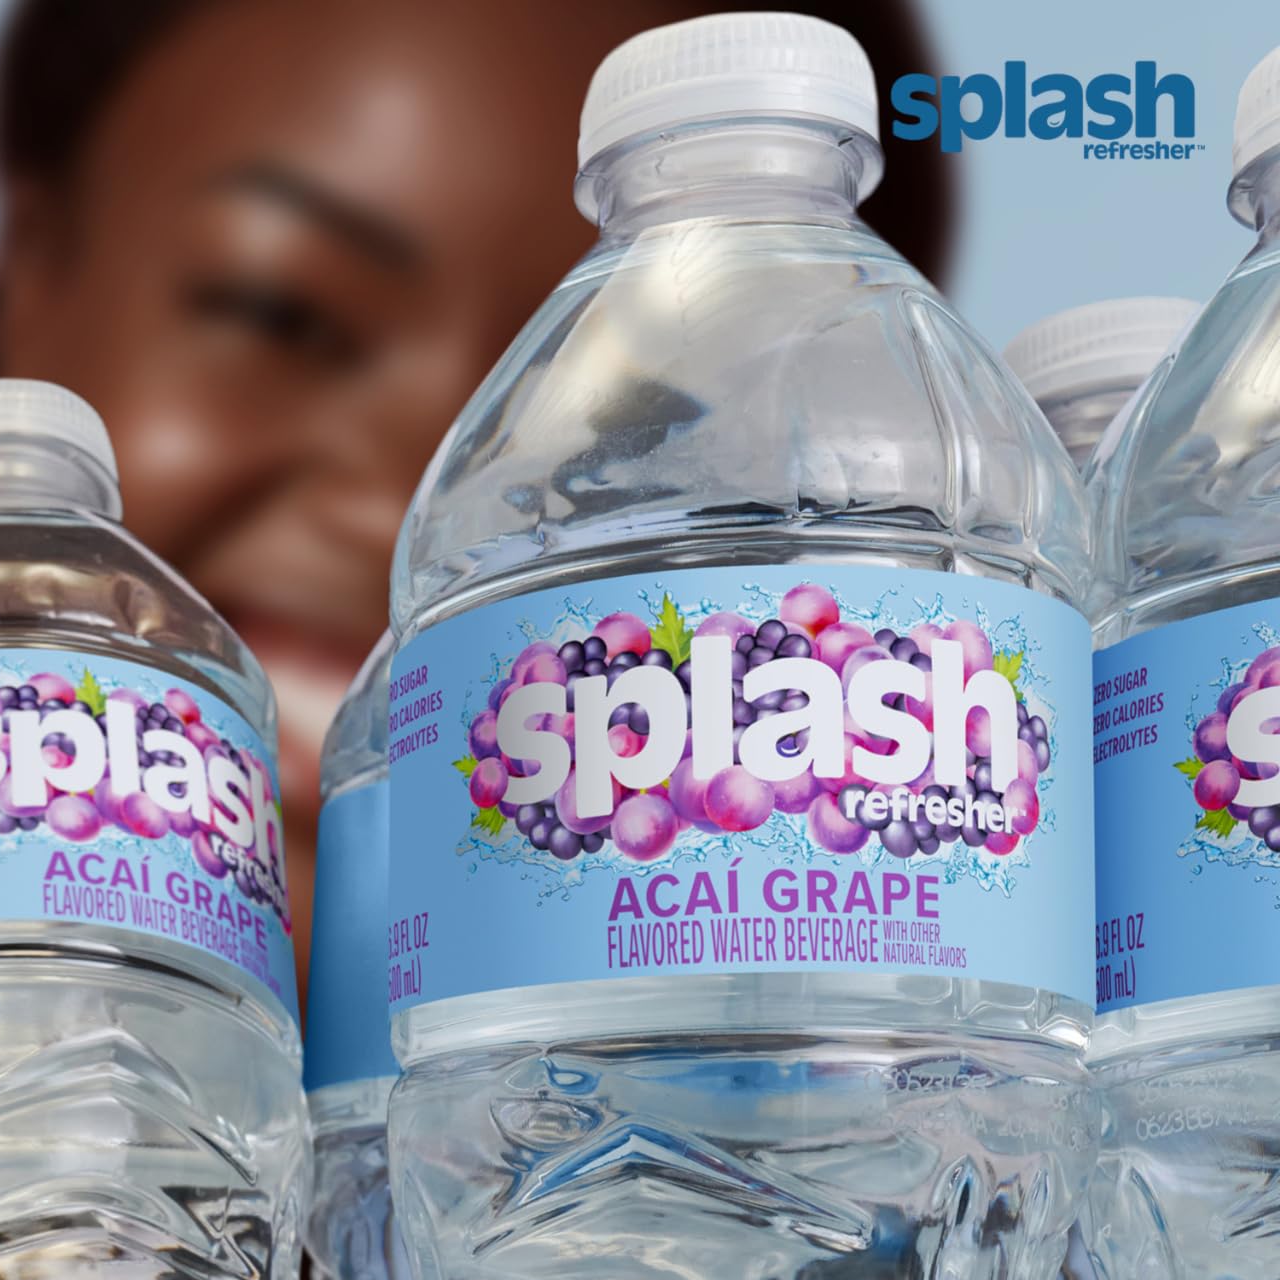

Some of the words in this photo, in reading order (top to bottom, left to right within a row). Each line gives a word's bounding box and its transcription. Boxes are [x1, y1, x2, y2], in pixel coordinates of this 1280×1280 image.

[400, 665, 428, 697] SUGAR
[1113, 667, 1148, 696] SUGAR
[400, 690, 443, 727] CALORIES
[495, 634, 1018, 821] splash
[1112, 692, 1164, 726] CALORIES
[389, 722, 439, 764] ECTROLYTES
[44, 850, 150, 894] ACAÍ
[166, 871, 268, 951] GRAPE
[608, 857, 743, 921] ACAÍ
[763, 868, 940, 918] GRAPE
[43, 884, 126, 923] FLAVORED
[129, 892, 177, 937] WATER
[180, 907, 239, 963] BEVERAGE
[401, 918, 413, 954] FL
[414, 912, 430, 949] OZ
[608, 919, 704, 969] FLAVORED
[711, 917, 777, 963] WATER
[784, 917, 879, 963] BEVERAGE
[883, 920, 908, 942] WITH
[911, 922, 941, 944] OTHER
[1095, 921, 1109, 960] 6.9
[1111, 917, 1124, 954] FL
[1127, 912, 1145, 951] OZ
[403, 953, 422, 996] mL)
[883, 944, 926, 966] NATURAL
[928, 945, 967, 969] FLAVORS
[1114, 955, 1136, 999] mL)
